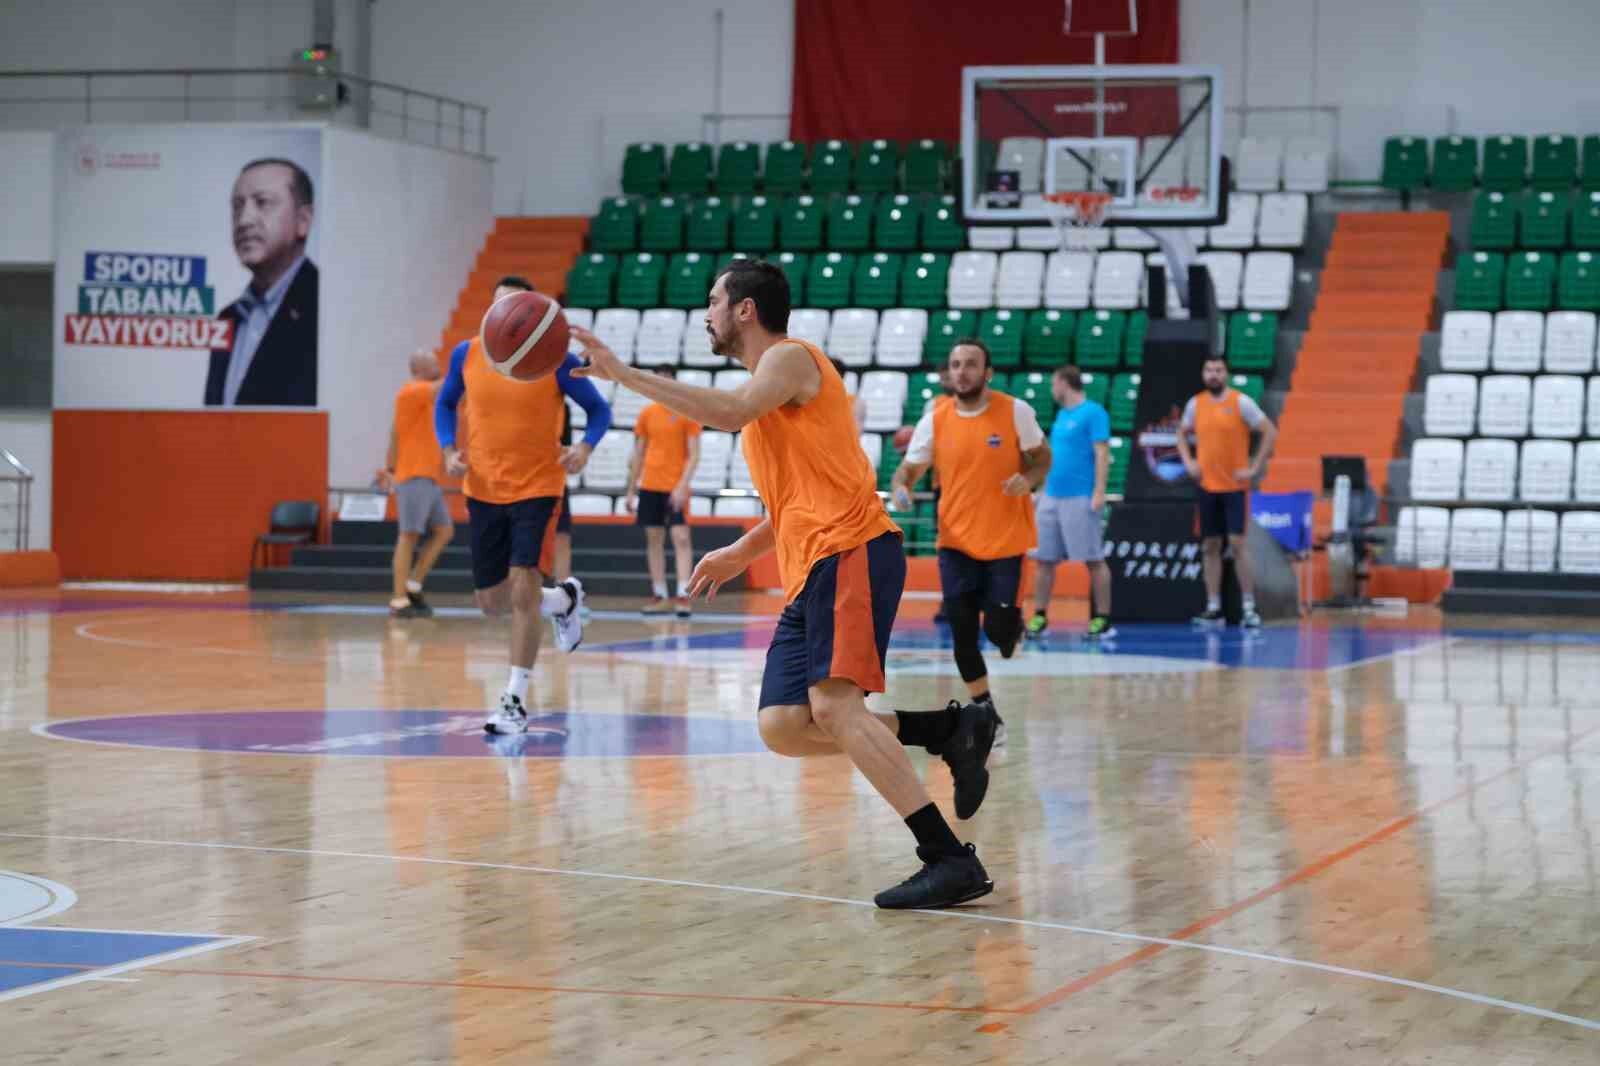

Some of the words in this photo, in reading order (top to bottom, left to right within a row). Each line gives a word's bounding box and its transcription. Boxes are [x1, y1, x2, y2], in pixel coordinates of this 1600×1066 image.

[95, 254, 193, 285] SPORU
[85, 287, 204, 315] TABANA
[69, 317, 230, 348] YAYIYORUZ
